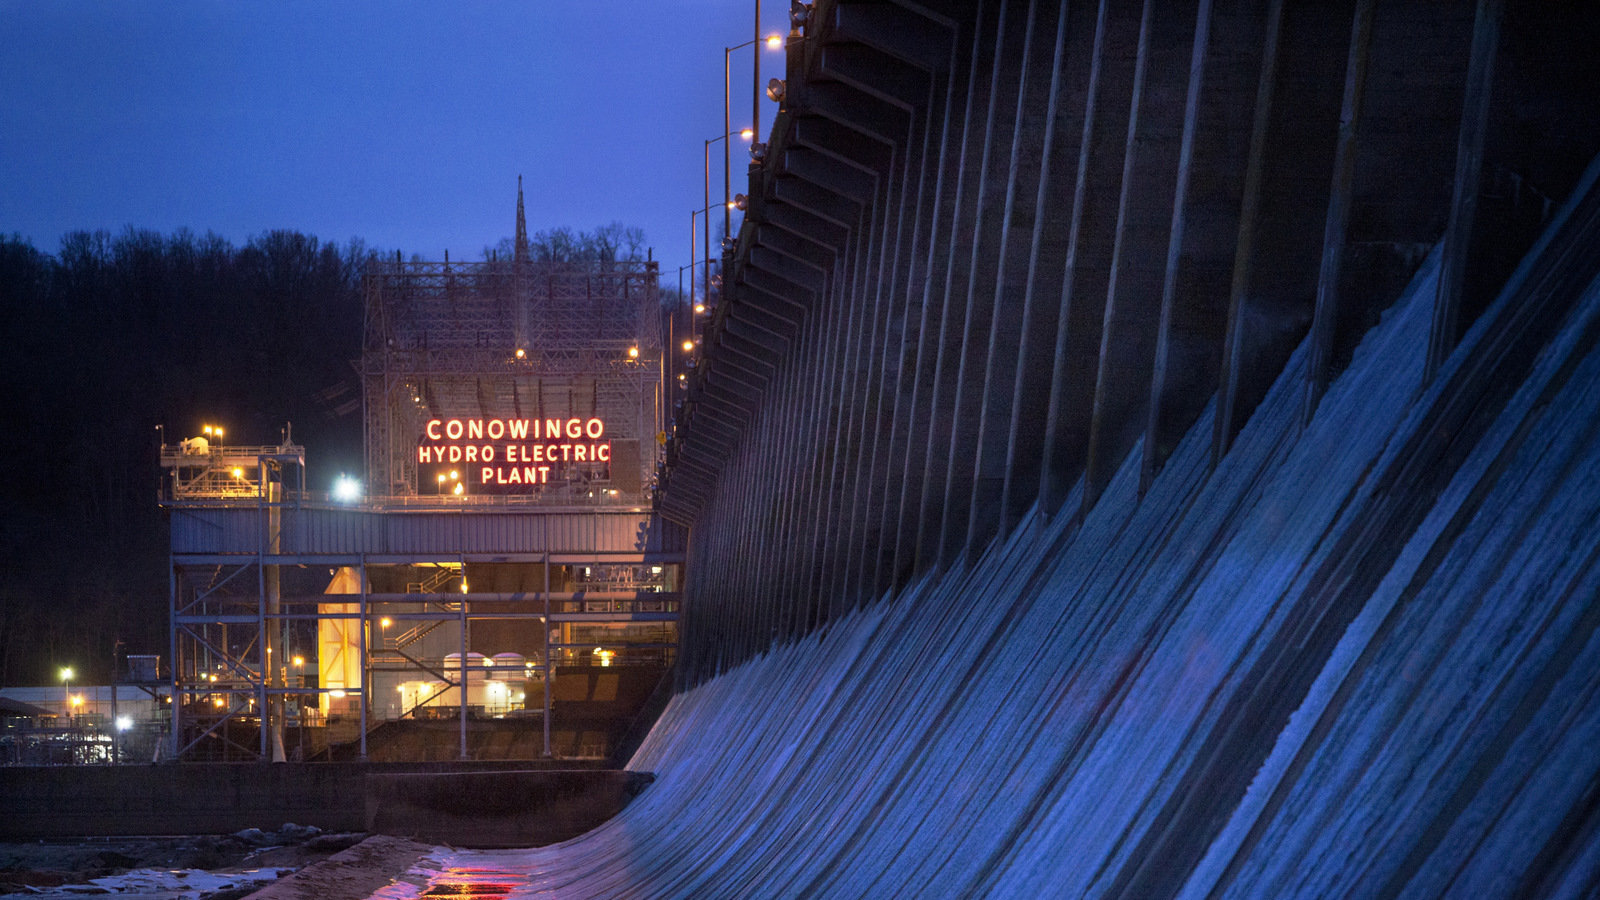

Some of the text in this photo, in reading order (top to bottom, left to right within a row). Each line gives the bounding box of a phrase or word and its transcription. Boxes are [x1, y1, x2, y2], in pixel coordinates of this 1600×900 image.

[426, 418, 604, 440] CONOWINGO
[418, 444, 609, 463] HYDRO ELECTRIC
[481, 466, 550, 484] PLANT
